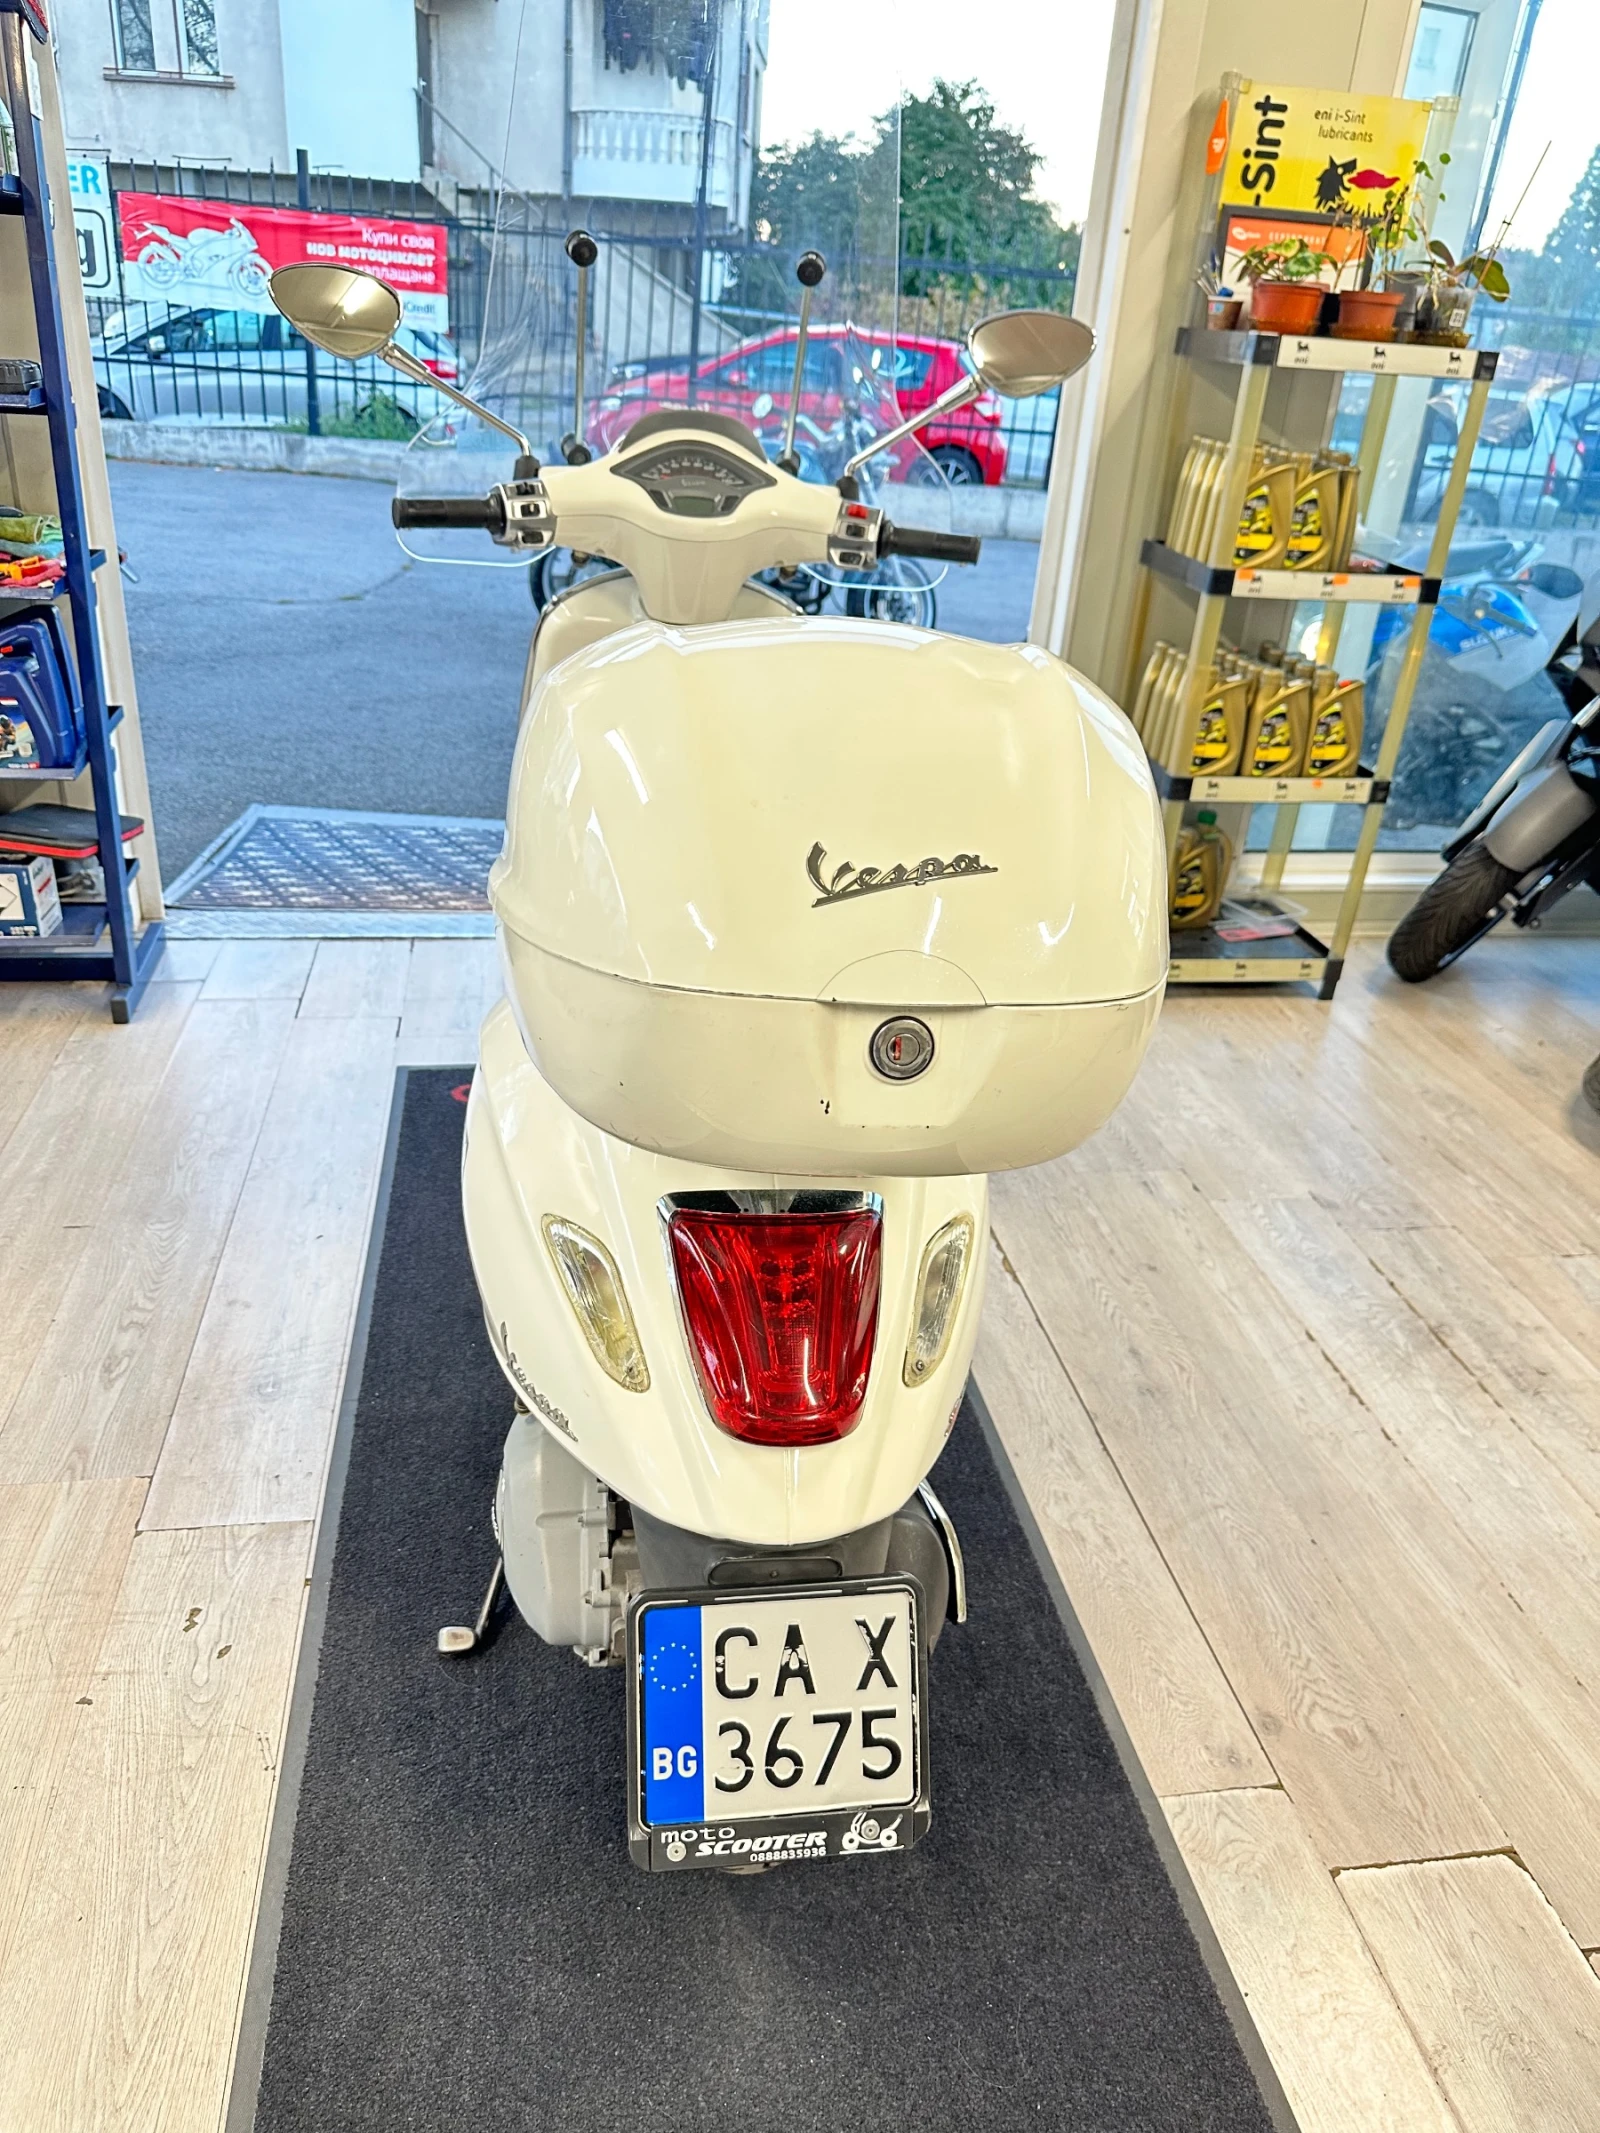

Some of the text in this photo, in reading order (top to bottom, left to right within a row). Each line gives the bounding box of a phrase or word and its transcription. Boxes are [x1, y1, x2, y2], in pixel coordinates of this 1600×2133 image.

[1314, 107, 1366, 125] eni i-Sint
[1318, 124, 1373, 143] lubricants
[361, 227, 435, 251] Купи своя
[306, 241, 436, 267] нов мотоциклет
[1294, 356, 1309, 365] eni
[1371, 361, 1385, 370] eni
[1446, 366, 1460, 375] eni
[806, 841, 999, 908] Vespa
[714, 1706, 902, 1793] 3675
[652, 1745, 698, 1781] BG
[660, 1826, 736, 1844] moto
[694, 1831, 828, 1857] SCOOTER
[749, 1846, 827, 1863] 0888835936
